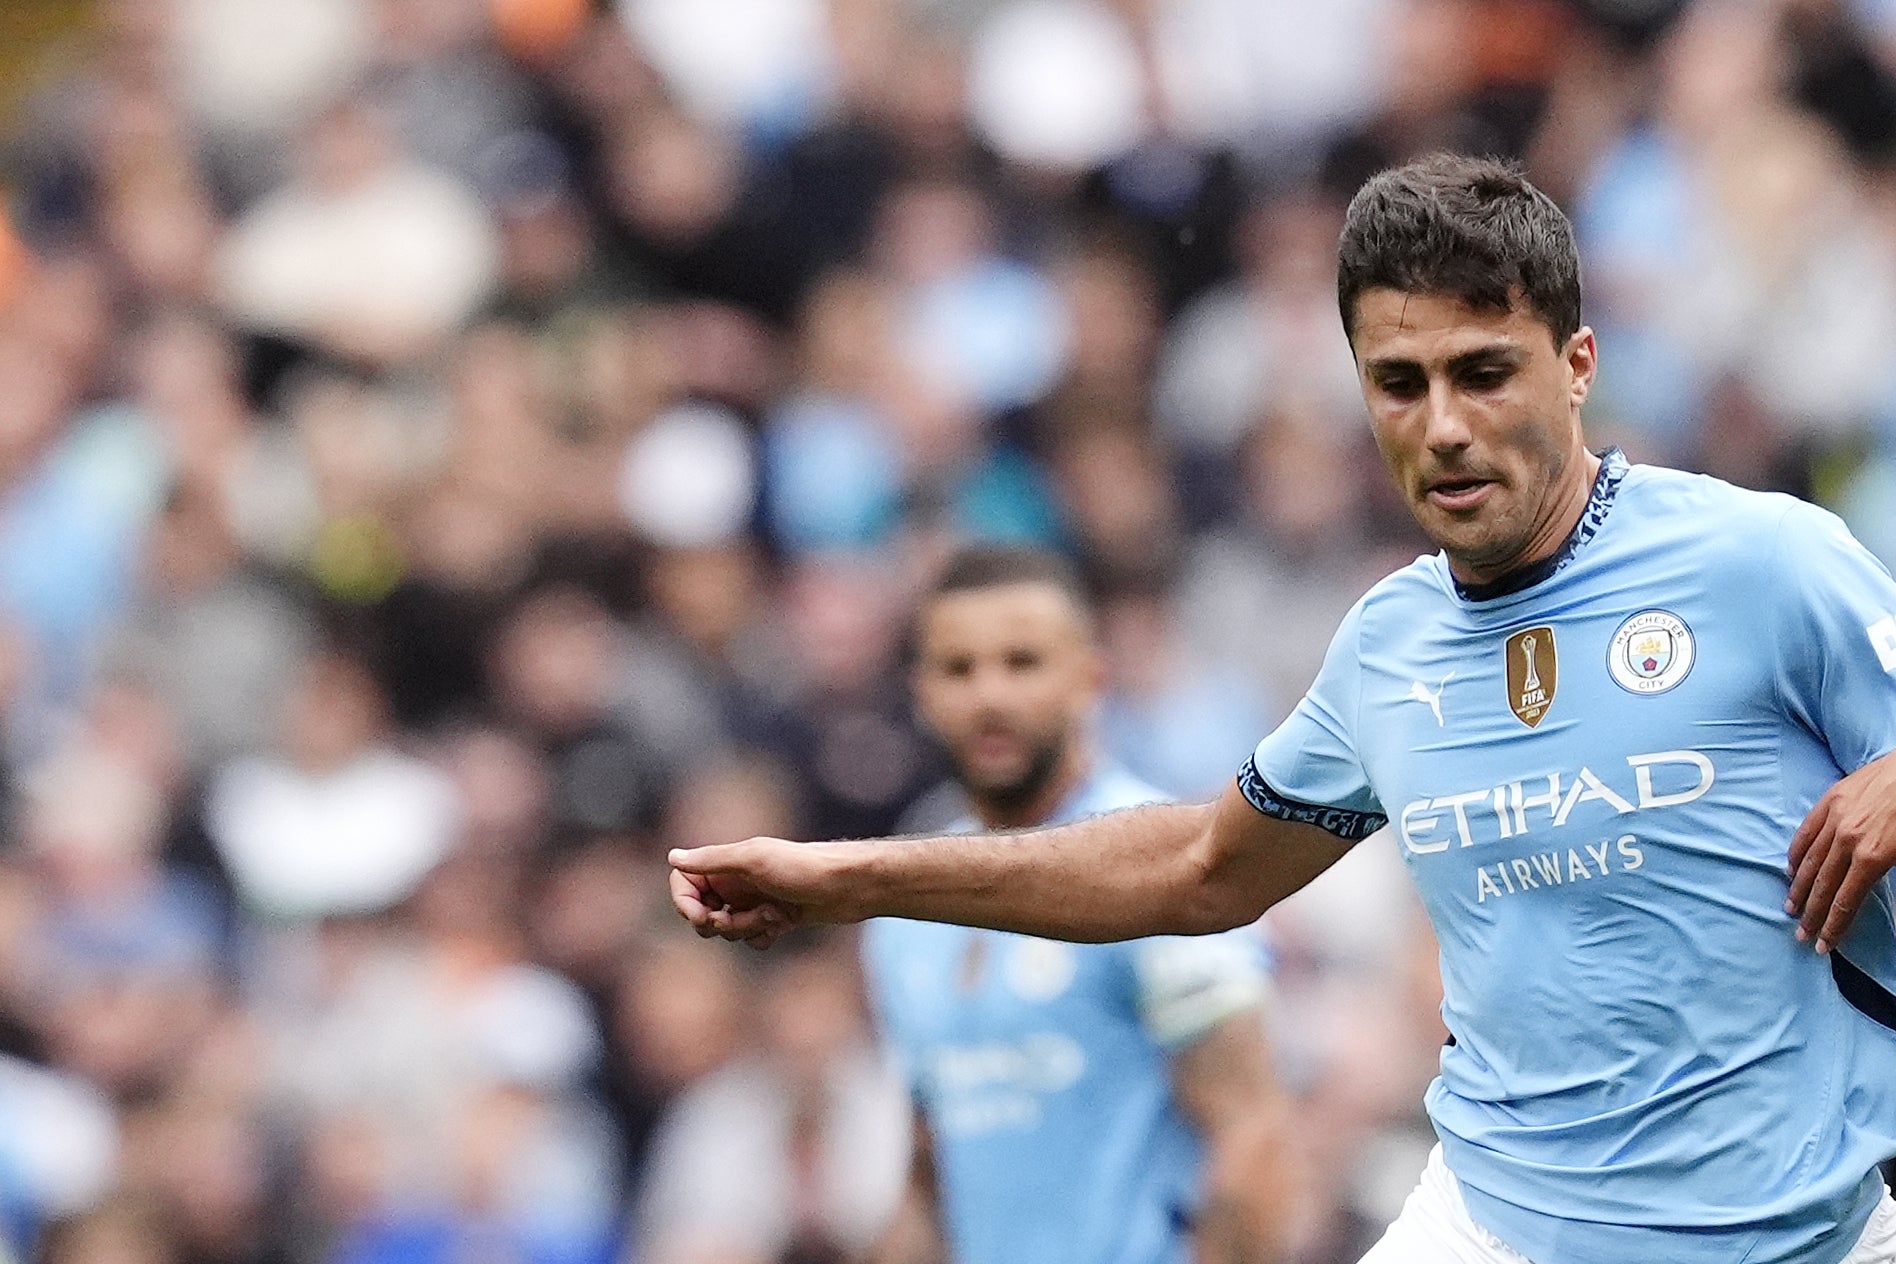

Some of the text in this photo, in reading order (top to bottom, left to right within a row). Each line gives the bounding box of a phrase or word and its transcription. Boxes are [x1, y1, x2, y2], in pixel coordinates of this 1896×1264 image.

[1617, 616, 1685, 645] MANCHESTER
[1521, 688, 1546, 707] FIFA
[1638, 680, 1665, 689] CITY
[1400, 750, 1715, 855] ETIHAD
[1477, 834, 1645, 903] AIRWAYS
